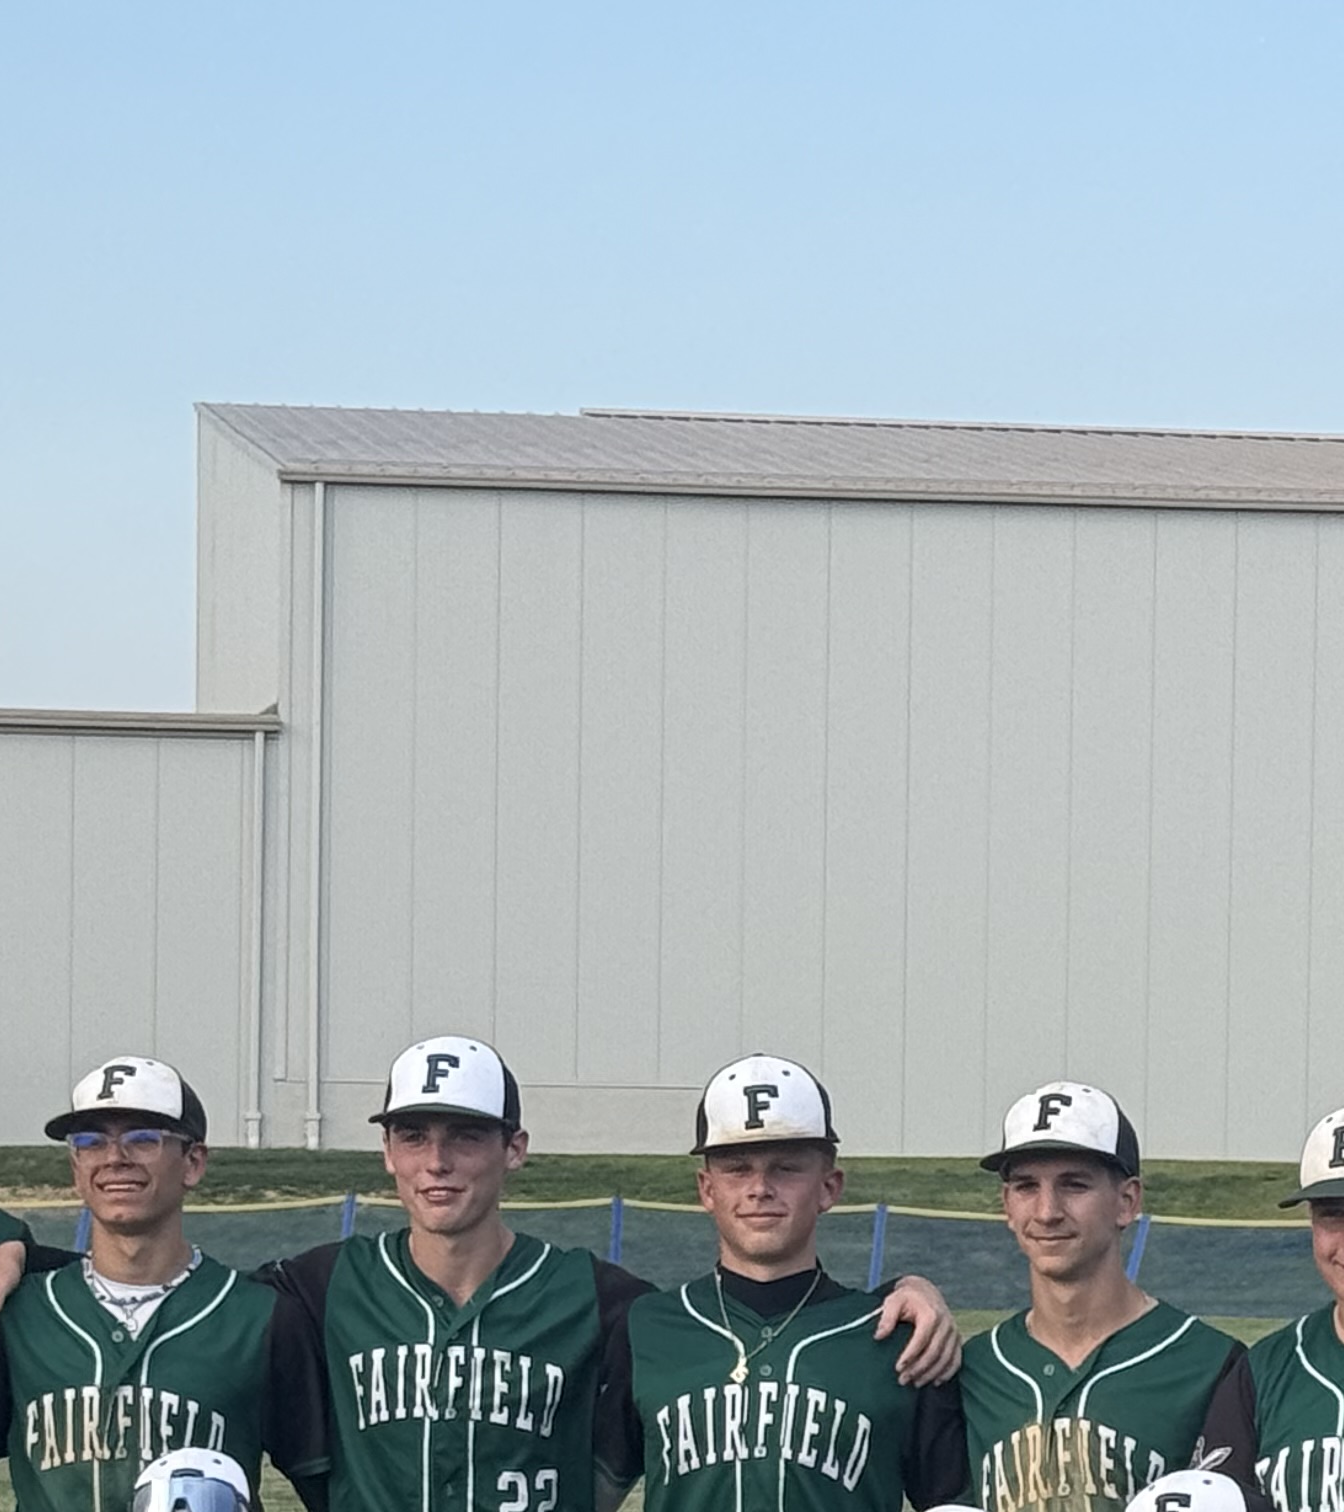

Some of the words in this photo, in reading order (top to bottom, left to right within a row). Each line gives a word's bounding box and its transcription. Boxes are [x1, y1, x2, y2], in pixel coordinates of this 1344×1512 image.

[98, 1066, 135, 1100] F
[422, 1054, 460, 1094] F
[744, 1085, 778, 1130] F
[1034, 1094, 1072, 1131] F
[349, 1343, 564, 1437] FAIRFIELD
[657, 1381, 872, 1492] FAIRFIELD
